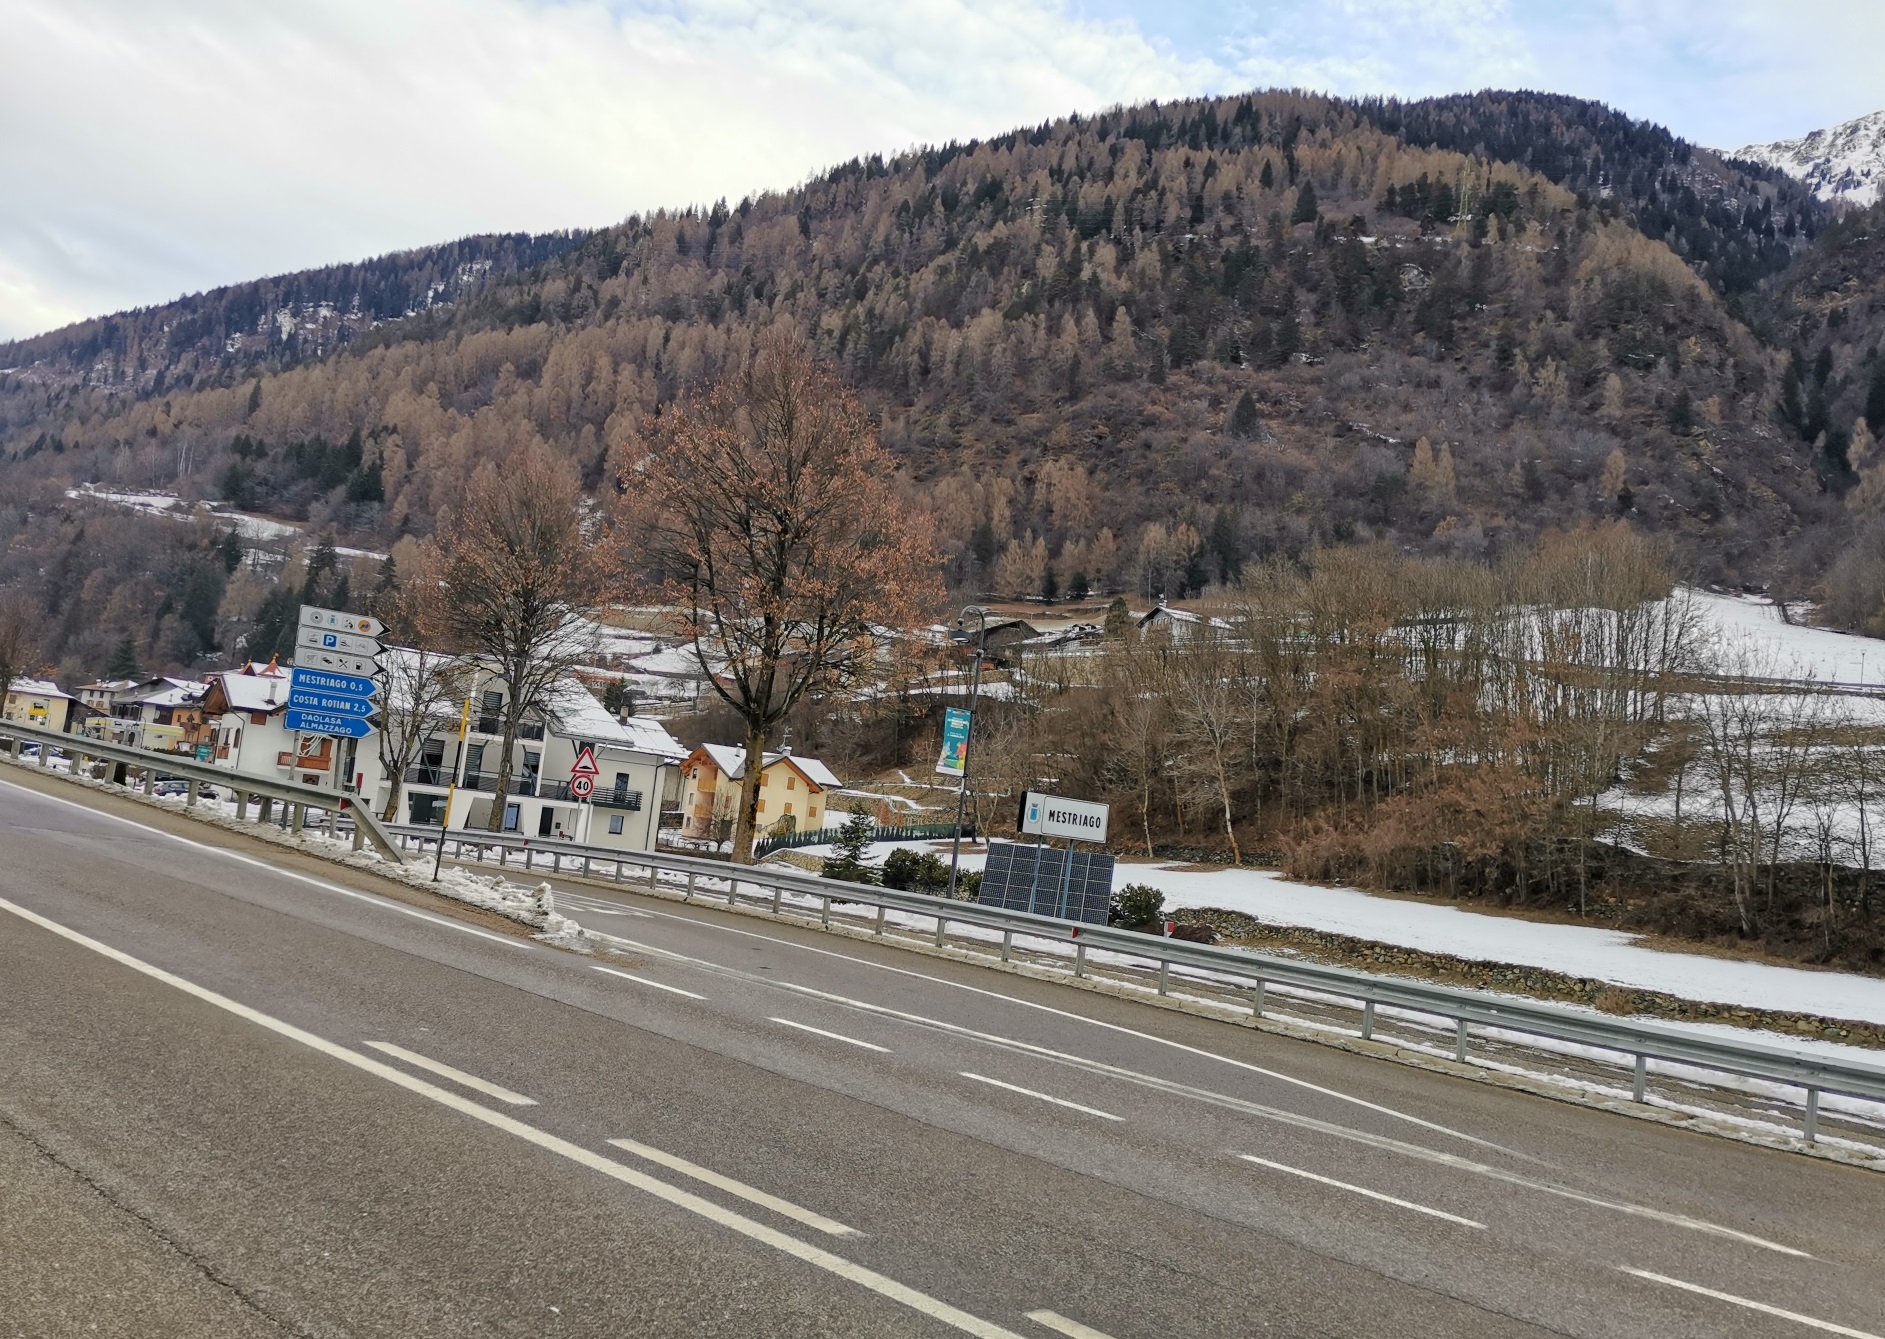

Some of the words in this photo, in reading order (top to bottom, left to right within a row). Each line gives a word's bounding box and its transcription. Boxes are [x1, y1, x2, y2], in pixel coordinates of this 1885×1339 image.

[298, 674, 347, 689] MESTRIAGO
[349, 682, 363, 692] 0.5
[293, 694, 319, 706] COSTA
[321, 698, 351, 710] ROTIAN
[353, 703, 366, 713] 2.5
[301, 713, 342, 725] DAOLASA
[299, 722, 352, 734] ALMAZZAGO
[576, 781, 589, 791] 40
[1047, 809, 1101, 829] MESTRIAGO
